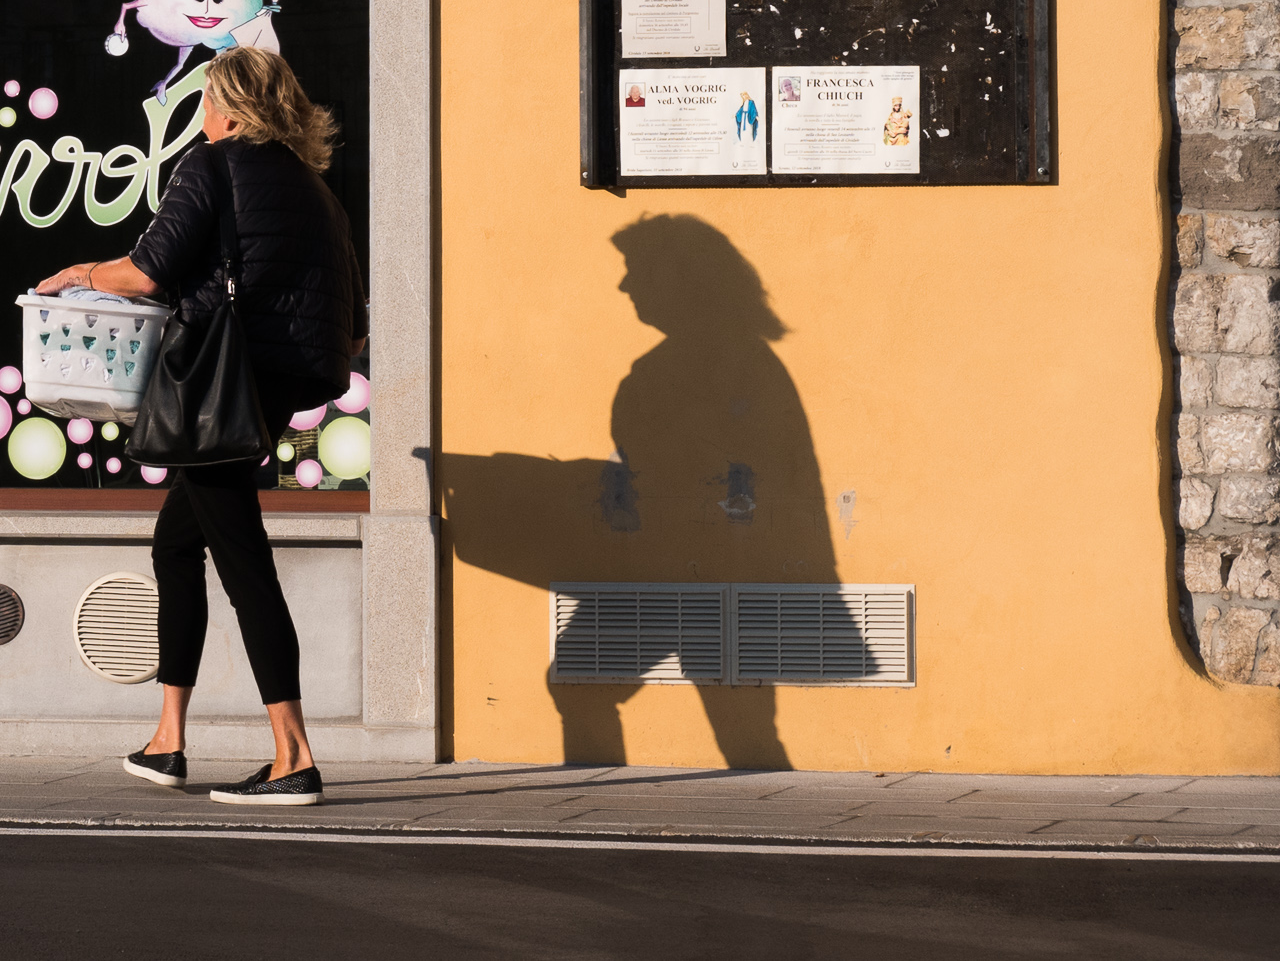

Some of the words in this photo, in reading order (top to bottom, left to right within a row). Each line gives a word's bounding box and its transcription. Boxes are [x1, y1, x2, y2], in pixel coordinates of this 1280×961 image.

[806, 78, 874, 88] FRANCESCA
[647, 85, 679, 94] ALMA
[684, 84, 727, 93] VOGRIG
[657, 97, 675, 105] ved.
[677, 96, 717, 105] VOGRIG
[817, 91, 863, 101] CHIUCH
